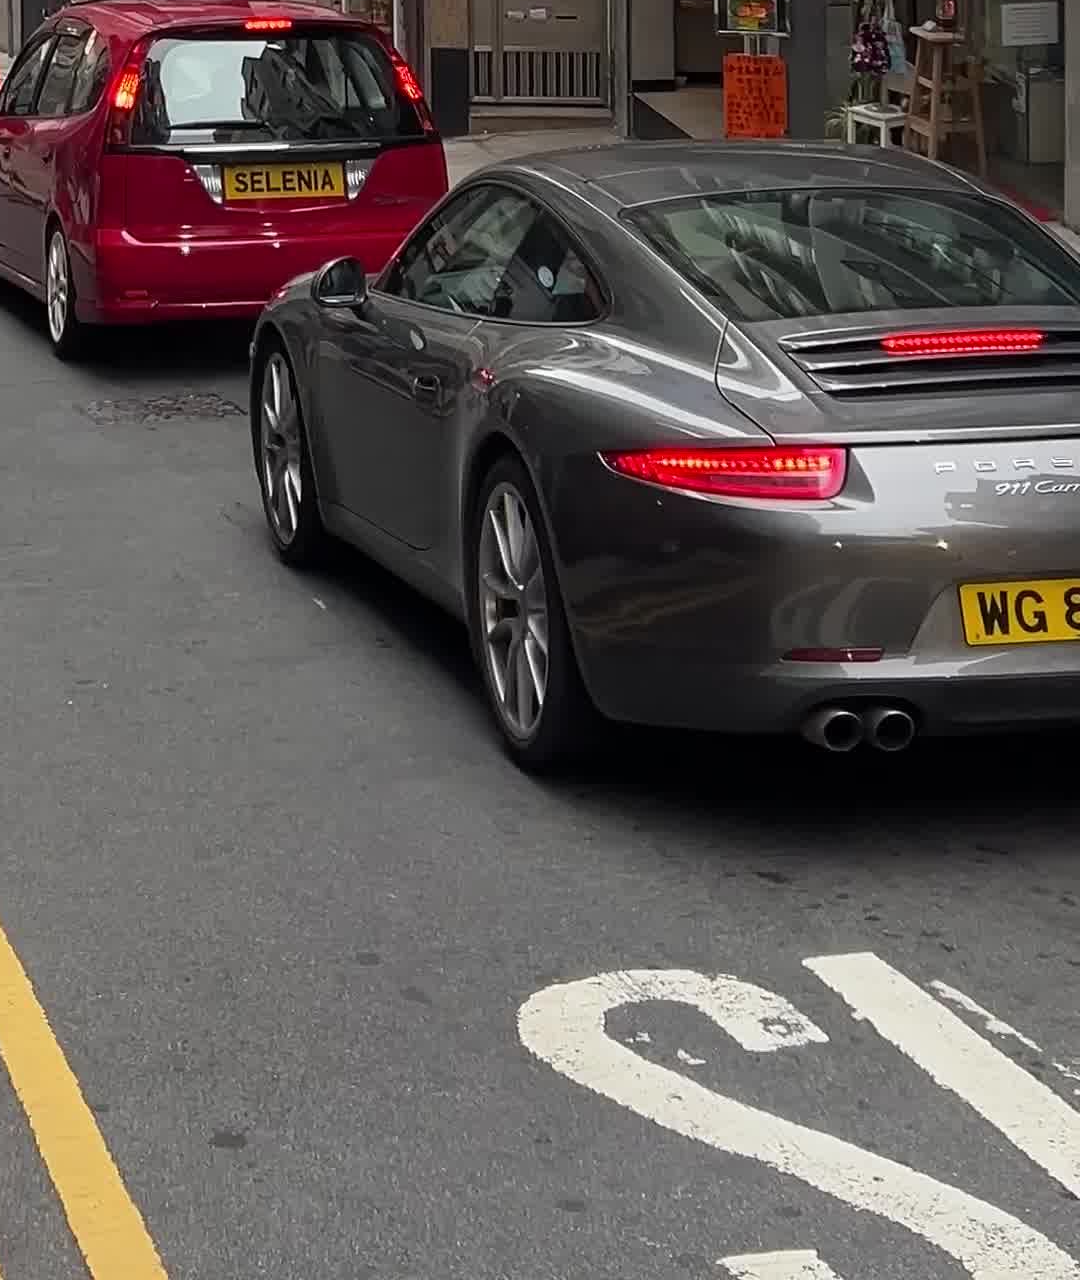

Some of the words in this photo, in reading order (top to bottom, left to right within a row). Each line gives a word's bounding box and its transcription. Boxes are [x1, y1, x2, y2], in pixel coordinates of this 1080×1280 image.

[234, 170, 335, 193] SELENIA
[995, 482, 1032, 495] 911
[976, 590, 1049, 636] WG
